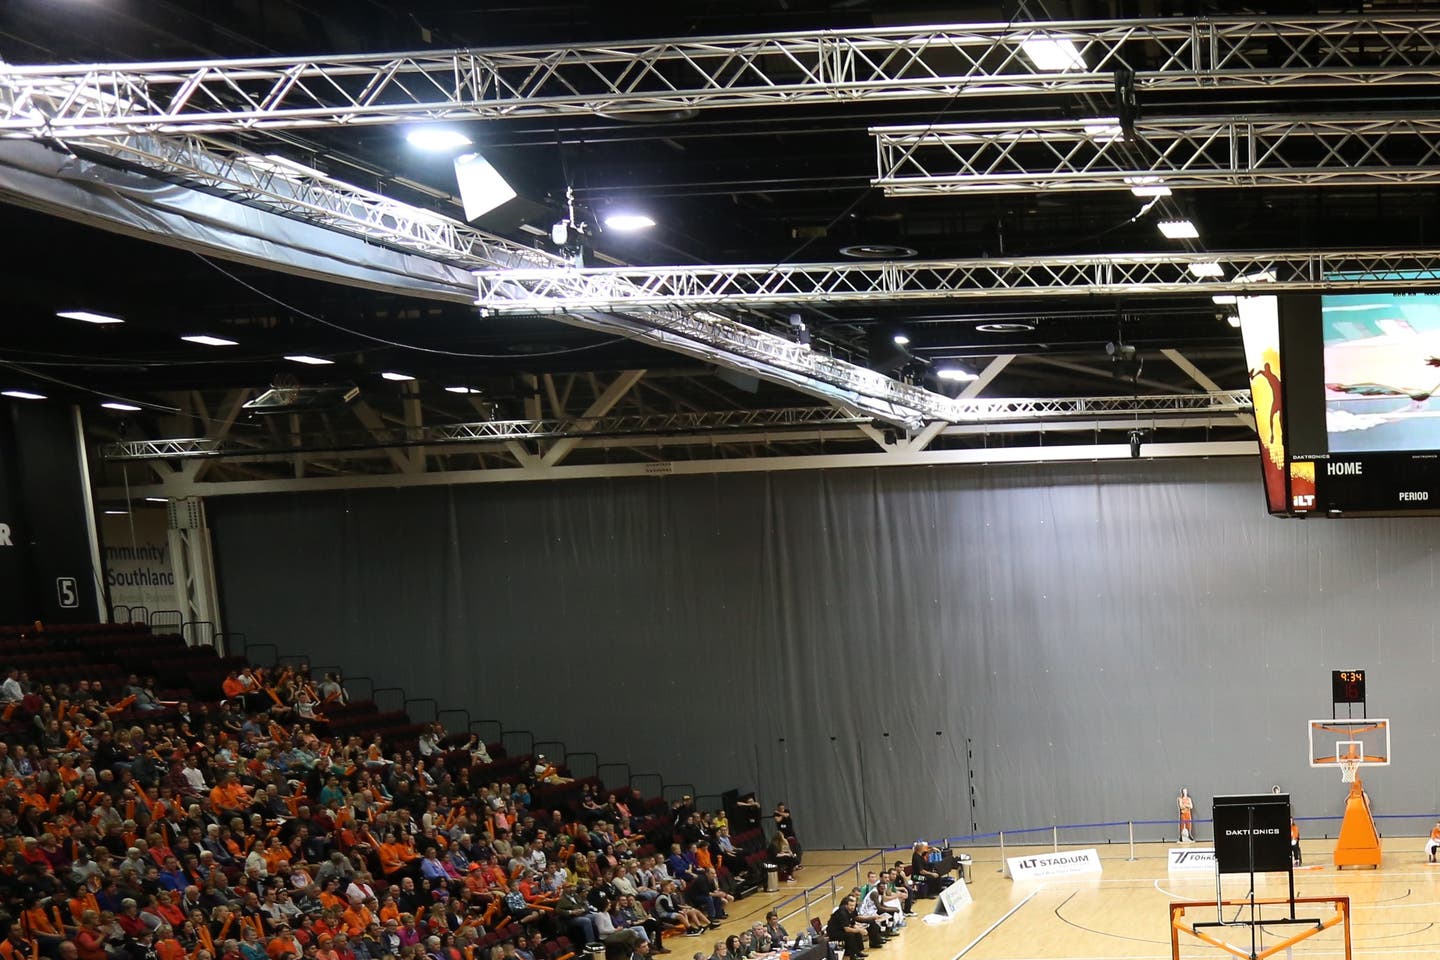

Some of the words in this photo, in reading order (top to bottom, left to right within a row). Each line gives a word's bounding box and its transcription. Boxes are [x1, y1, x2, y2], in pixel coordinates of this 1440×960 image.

[1327, 462, 1362, 475] HOME
[1399, 492, 1428, 500] PERIOD
[63, 581, 74, 605] 5
[1341, 673, 1361, 682] 9:34
